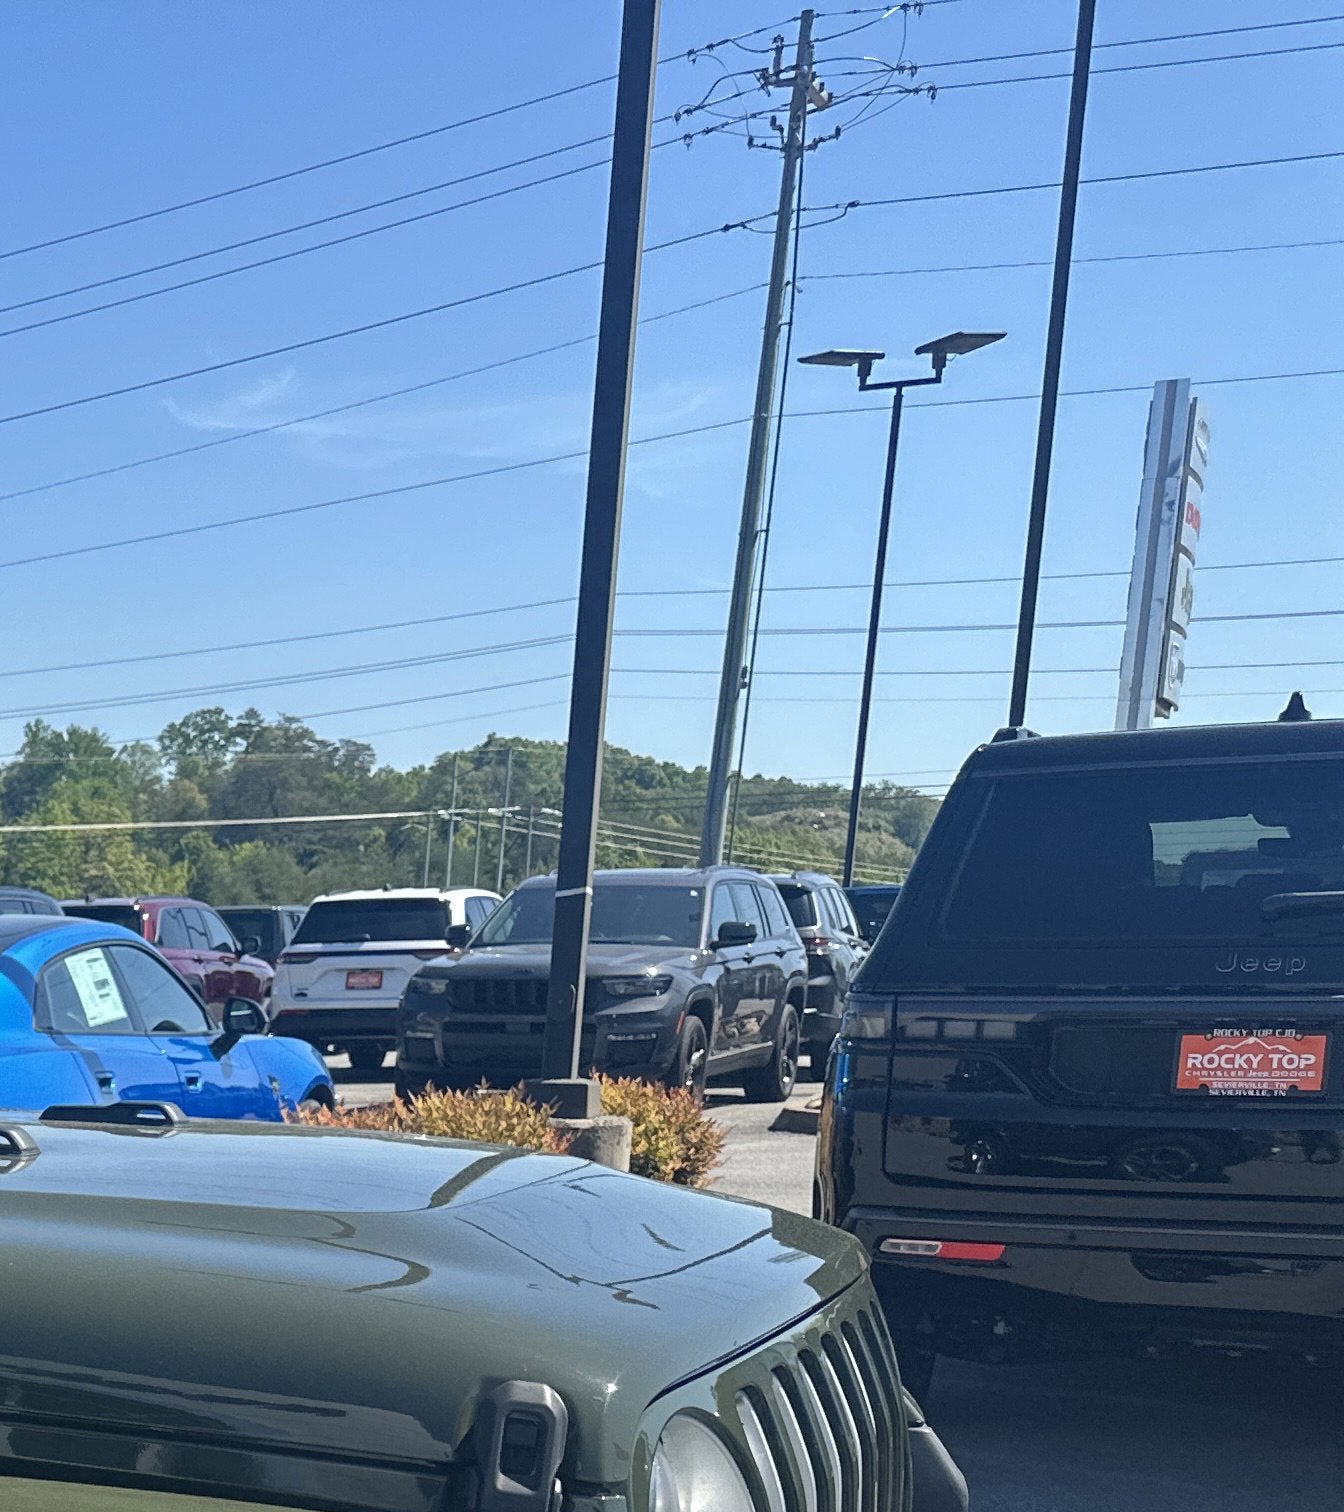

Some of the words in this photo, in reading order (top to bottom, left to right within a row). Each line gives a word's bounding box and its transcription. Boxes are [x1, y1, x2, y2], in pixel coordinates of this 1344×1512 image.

[1215, 952, 1306, 975] Jeep
[1213, 1028, 1249, 1037] ROCKY
[1186, 1053, 1264, 1069] ROCKY
[1268, 1053, 1316, 1069] TOP
[1247, 1069, 1269, 1078] Jeep
[1274, 1081, 1288, 1089] TN
